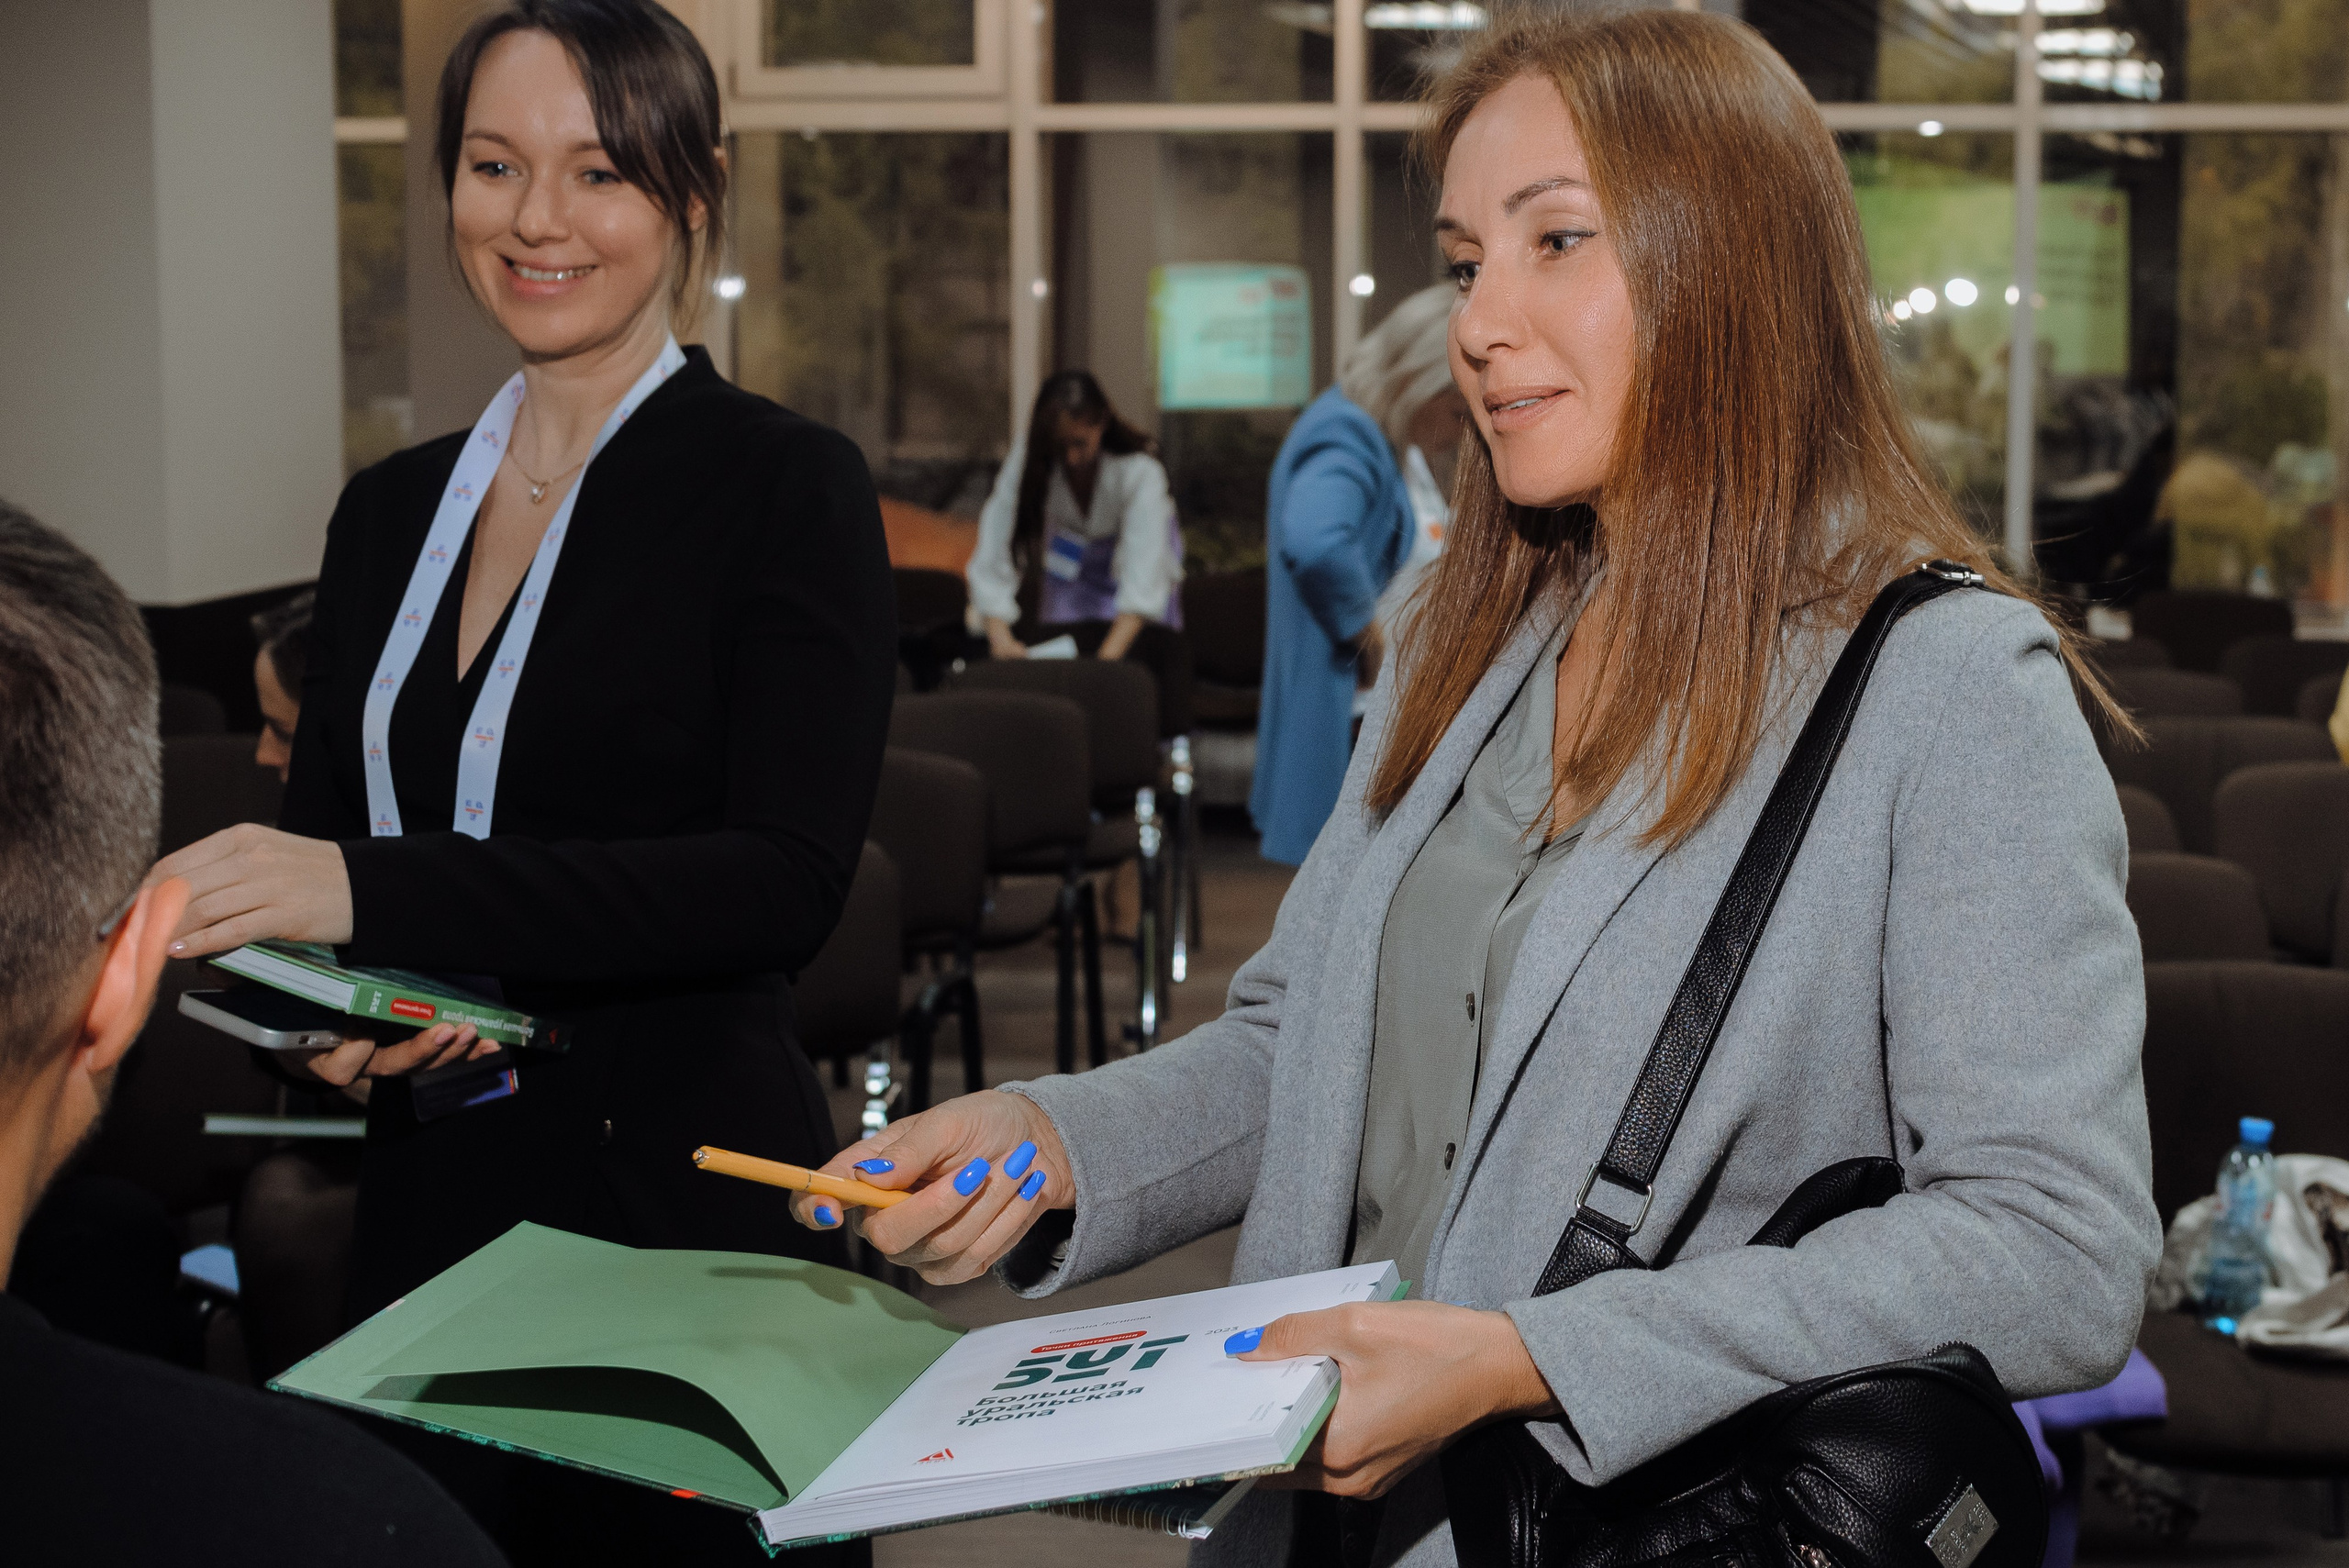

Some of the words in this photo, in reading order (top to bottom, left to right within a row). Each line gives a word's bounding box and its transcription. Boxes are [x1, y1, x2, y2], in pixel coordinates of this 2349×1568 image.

[1073, 1333, 1139, 1347] притяжения
[1204, 1326, 1239, 1336] 2023
[961, 1386, 1145, 1418] уральская
[975, 1380, 1128, 1407] Большая
[956, 1409, 1056, 1427] тропа
